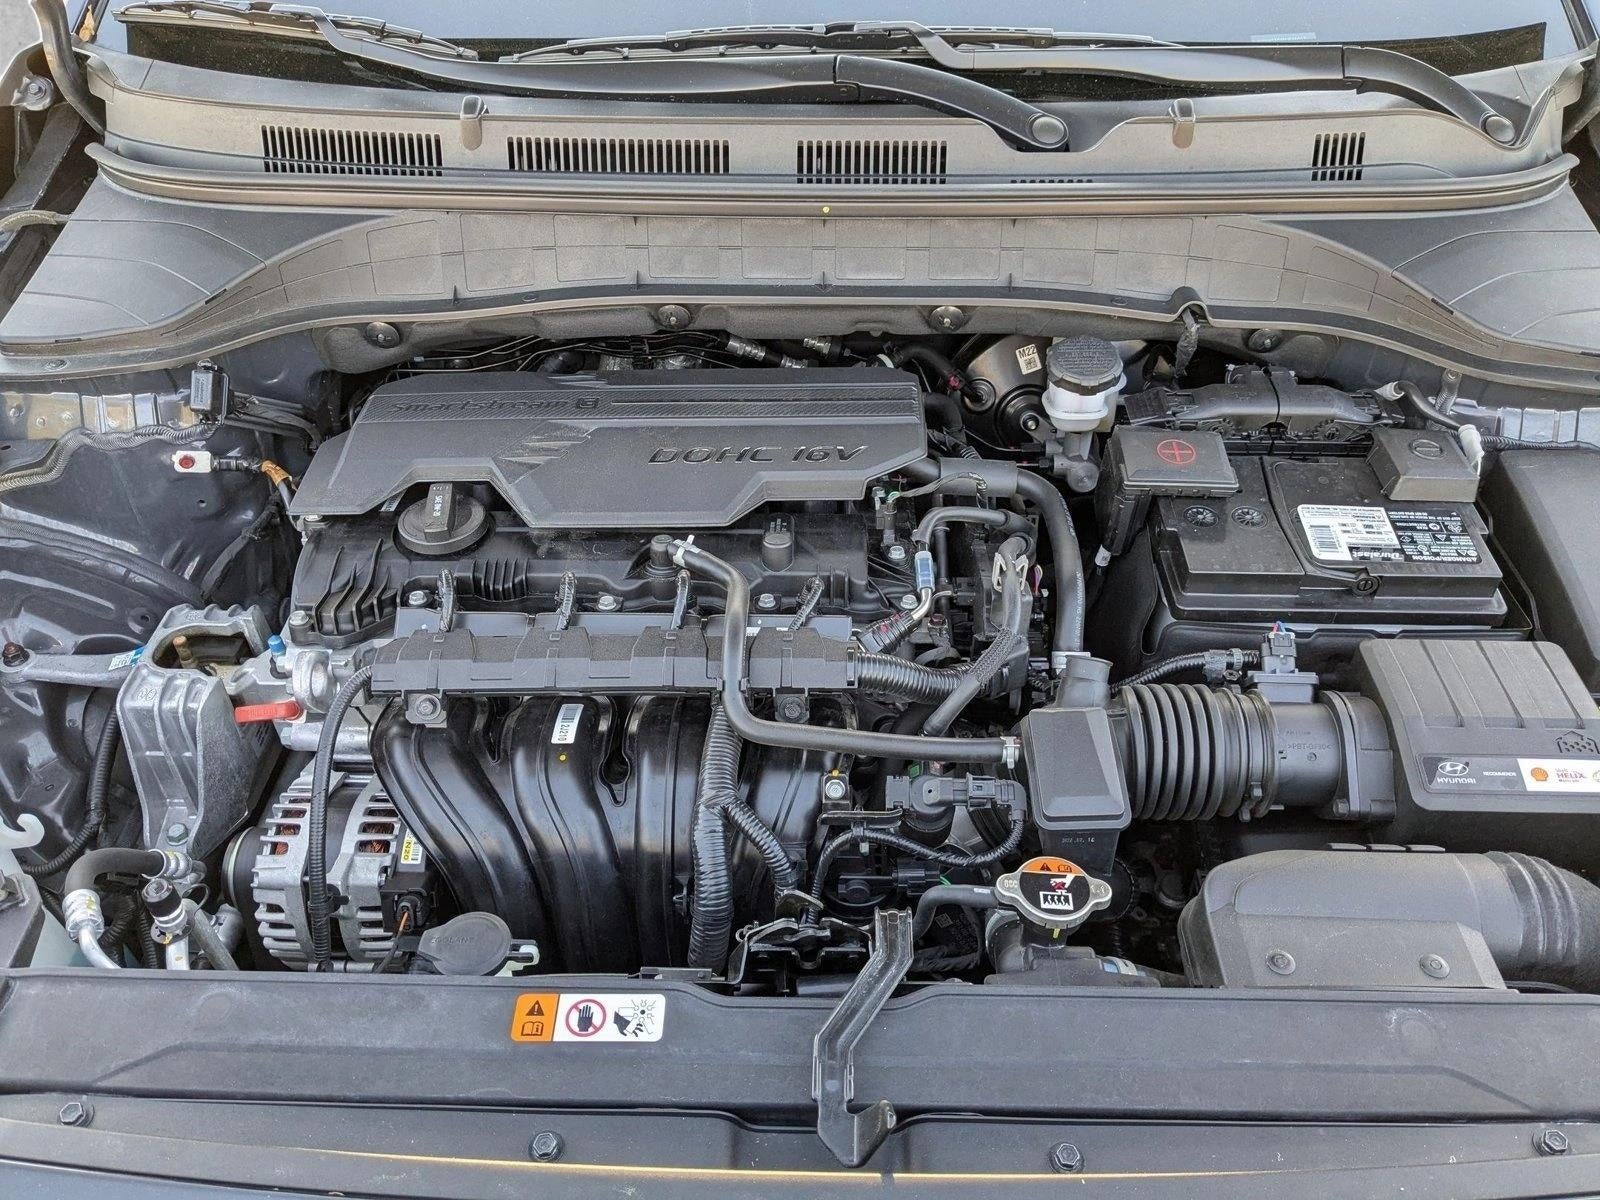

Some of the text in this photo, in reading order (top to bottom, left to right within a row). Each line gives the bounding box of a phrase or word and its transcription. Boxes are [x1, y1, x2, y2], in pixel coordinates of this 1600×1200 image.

[1018, 345, 1038, 359] M22
[648, 446, 868, 464] DOHC 16V
[1352, 551, 1403, 560] Duralast
